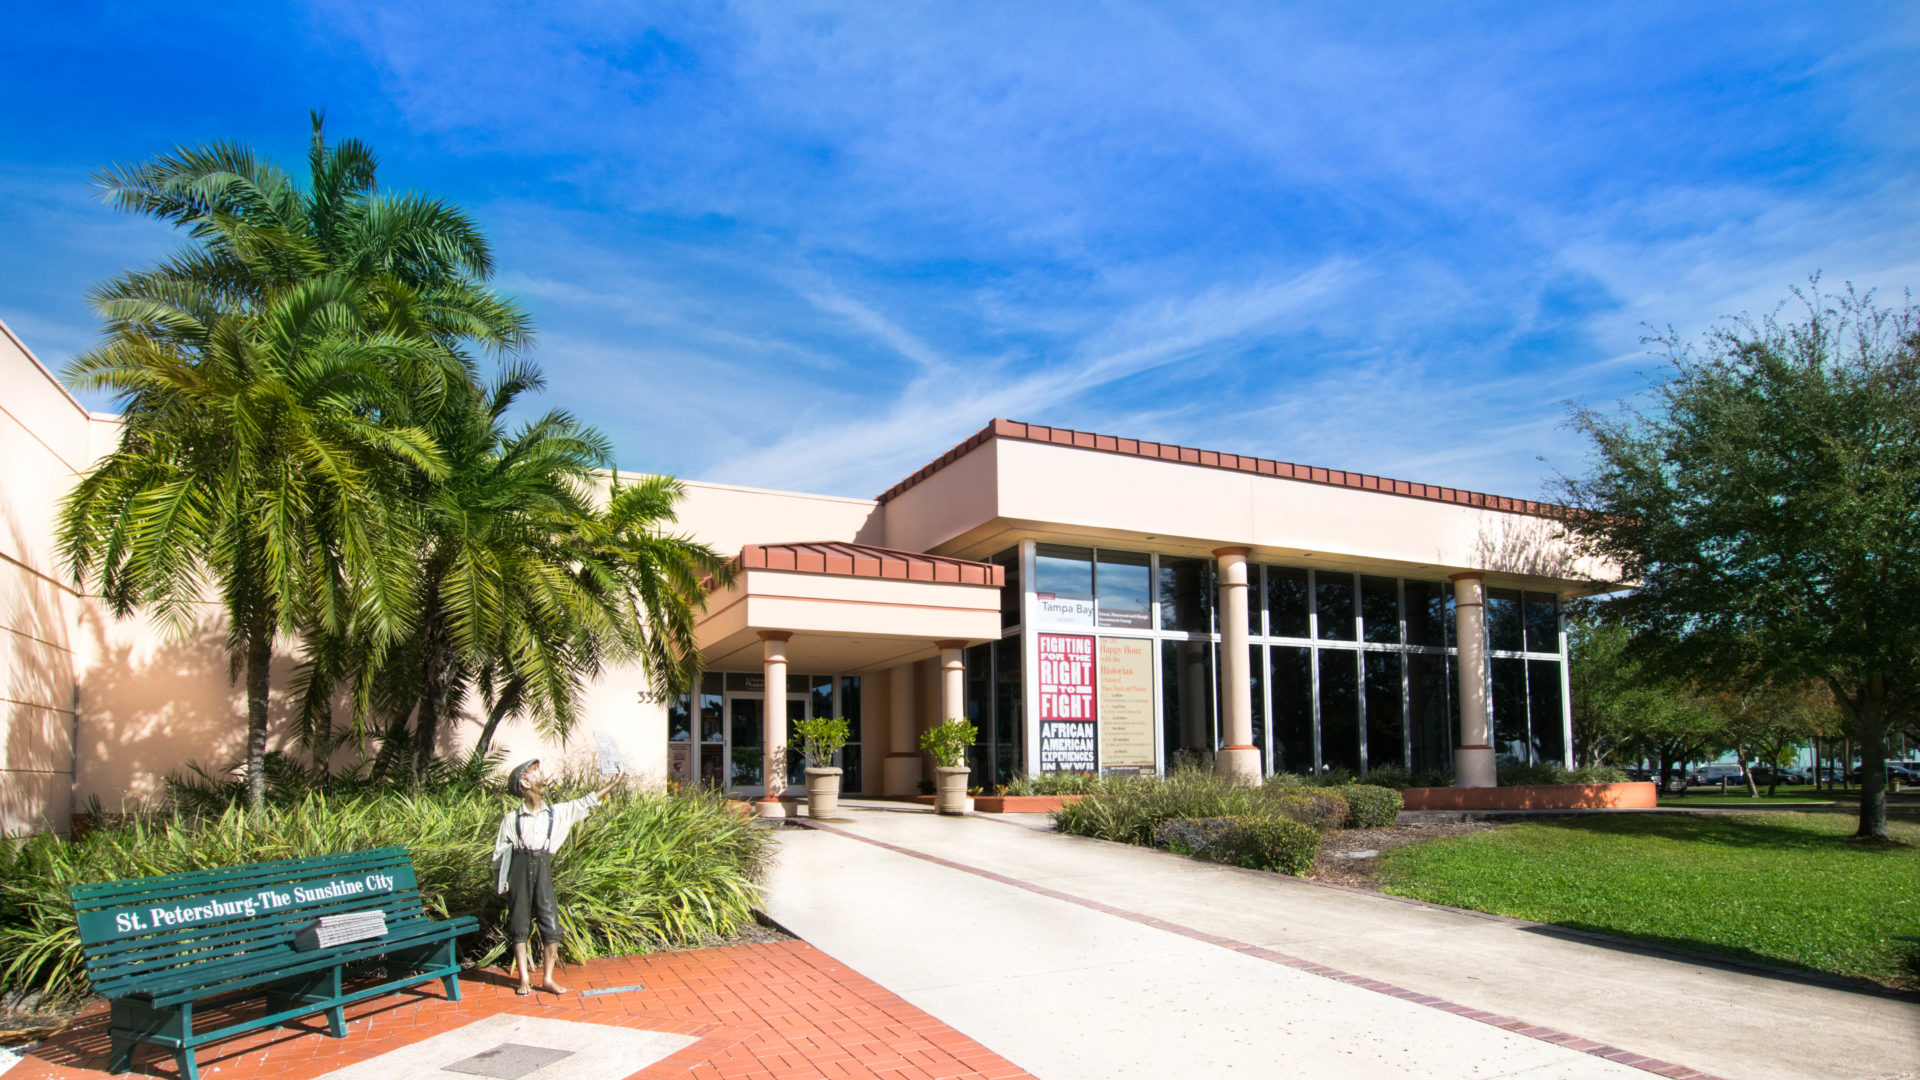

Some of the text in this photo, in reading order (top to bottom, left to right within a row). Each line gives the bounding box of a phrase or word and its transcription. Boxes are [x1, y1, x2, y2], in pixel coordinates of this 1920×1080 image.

[1042, 602, 1074, 614] Tampa
[1076, 604, 1093, 617] Bay
[1040, 636, 1091, 654] FIGHTING
[1100, 644, 1142, 657] Happy Hour
[1068, 654, 1091, 662] THE
[1041, 660, 1092, 685] RIGHT
[1100, 665, 1134, 675] Historian
[1059, 685, 1076, 693] TO
[1041, 694, 1092, 718] FIGHT
[1041, 722, 1094, 738] AFRICAN
[1042, 738, 1094, 751] AMERICAN
[1041, 751, 1095, 762] EXPERIENCES
[1042, 762, 1056, 770] IN
[1059, 762, 1094, 770] WWII
[116, 911, 148, 933] St.
[293, 879, 364, 903] Sunshine
[365, 872, 394, 892] City
